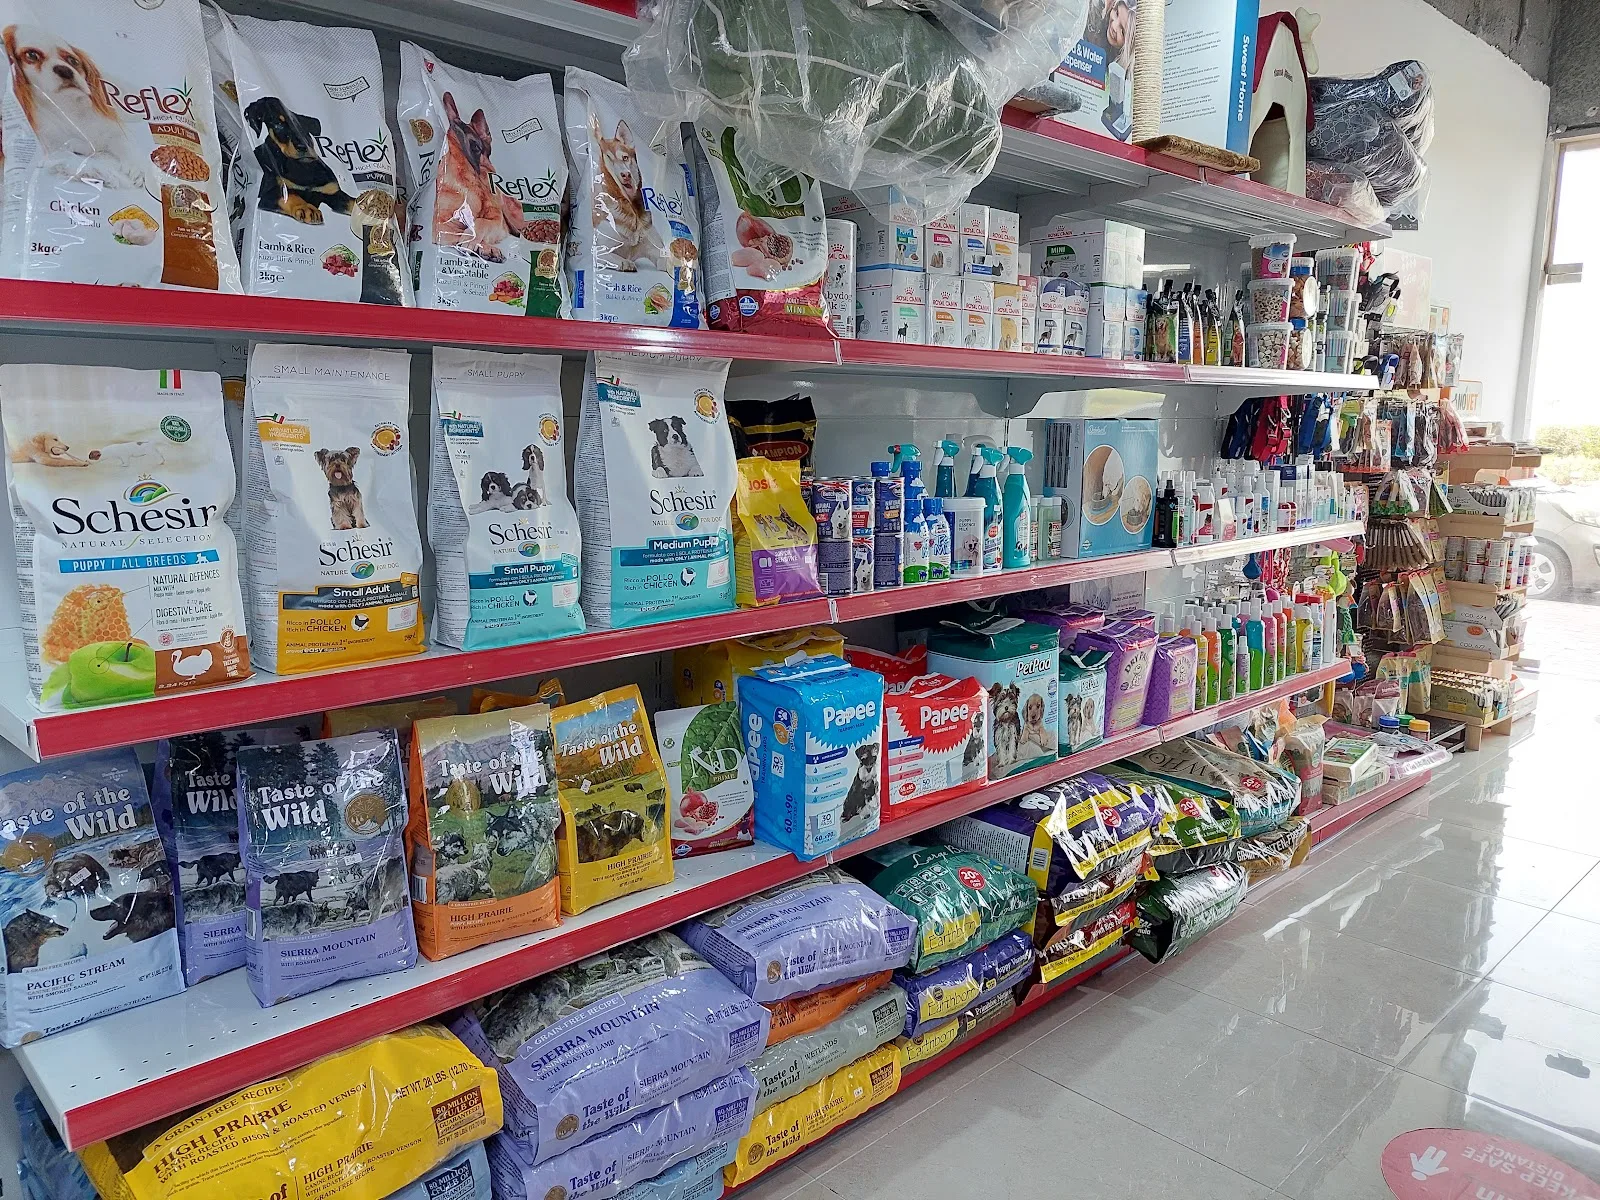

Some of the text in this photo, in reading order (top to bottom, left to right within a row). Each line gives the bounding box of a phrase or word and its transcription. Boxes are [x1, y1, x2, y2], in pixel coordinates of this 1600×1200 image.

[1082, 45, 1103, 65] Water
[1236, 34, 1250, 122] Sweet Home
[99, 79, 195, 121] Reflex
[157, 125, 186, 136] ADULT
[314, 136, 391, 171] Reflex
[488, 171, 559, 200] Reflex
[259, 241, 315, 255] Lamb Rice
[273, 365, 390, 381] SMALL MAINTENANCE
[467, 369, 526, 379] SMALL PUPPY
[649, 489, 717, 515] Schesir
[51, 497, 218, 535] Schesir
[61, 534, 213, 549] NATURAL SELECTION
[488, 522, 553, 546] Schesir
[653, 540, 692, 550] Medium
[73, 554, 187, 572] PUPPY ALL BREEDS
[318, 538, 393, 566] Schesir
[152, 573, 188, 585] NATURAL
[504, 563, 556, 575] Small Puppy
[646, 573, 674, 582] POLLO
[333, 583, 391, 597] Small Adult
[643, 580, 678, 590] CHICKEN
[155, 605, 193, 618] DIGESTIVE
[487, 600, 520, 609] CHICKEN
[306, 624, 347, 632] CHICKEN
[309, 618, 341, 626] POLLO
[1015, 656, 1052, 677] PetPad
[1124, 652, 1139, 674] DRY
[823, 700, 876, 730] Papee
[920, 703, 969, 730] Papee
[560, 723, 638, 757] Taste the
[600, 736, 644, 766] Wild
[437, 752, 510, 777] Taste of
[773, 755, 780, 771] 30
[185, 770, 231, 788] Taste
[488, 764, 549, 795] Wild
[712, 773, 735, 783] PRIME
[922, 778, 931, 786] 50
[63, 786, 131, 814] of the
[257, 784, 315, 805] Taste
[65, 803, 137, 840] Wild
[261, 799, 329, 831] Wild
[784, 819, 793, 834] 60
[822, 813, 831, 822] 30
[607, 851, 654, 871] HIGH PRAIRIE
[913, 851, 949, 868] Large
[450, 905, 514, 922] HIGH PRAIRIE
[736, 894, 833, 935] SIERRA MOUNTAIN
[737, 902, 773, 921] GRAIN-FREE
[203, 925, 242, 939] SIERRA
[762, 921, 787, 937] ROASTED
[280, 932, 377, 958] SIERRA MOUNTAIN
[807, 950, 818, 962] of
[27, 973, 76, 991] PACIFIC
[79, 957, 126, 979] STREAM
[295, 957, 321, 967] ROASTED
[797, 962, 817, 977] Wild
[45, 987, 72, 998] SMOKED
[73, 980, 98, 991] SALMON
[927, 986, 977, 1017] Earthborn
[73, 1016, 85, 1024] of
[534, 1012, 587, 1045] GRAIN-FREE
[587, 998, 618, 1016] RECIPE
[530, 1002, 661, 1072] SIERRA MOUNTAIN
[906, 1027, 955, 1061] Earthborn
[536, 1042, 591, 1077] CANINE RECIPE
[539, 1039, 616, 1081] WITH ROASTED LAMB
[804, 1038, 838, 1061] WETLANDS
[396, 1062, 469, 1100] NET WT. 28 LBS. (12.70
[639, 1070, 669, 1089] SIERRA
[671, 1050, 711, 1075] MOUNTAIN
[761, 1070, 787, 1088] Taste
[789, 1059, 799, 1072] of
[763, 1070, 801, 1098] the Wild
[435, 1090, 478, 1116] 80 MILLION
[468, 1097, 479, 1109] OF
[582, 1086, 630, 1118] Taste of
[604, 1099, 632, 1120] Wild
[805, 1096, 845, 1122] HIGH PRAIRIE
[153, 1099, 239, 1153] A GRAIN-FREE
[439, 1105, 481, 1129] GUARANTEED
[153, 1099, 292, 1175] HIGH PRAIRIE
[160, 1082, 368, 1185] WITH ROASTED BISON ROASTED VENISON
[655, 1125, 697, 1148] MOUNTAIN
[765, 1120, 799, 1146] Taste of
[766, 1131, 801, 1157] the Wild
[157, 1134, 236, 1179] CANINE RECIPE
[303, 1141, 375, 1184] HIGH PRAIRIE
[305, 1137, 422, 1197] WITH ROASTED VENISON
[1460, 1146, 1516, 1175] SAFE
[1482, 1143, 1565, 1182] DISTANCE
[314, 1164, 376, 1200] GRAIN-FREE RECIPE
[438, 1165, 469, 1183] MILLION
[569, 1160, 617, 1190] Taste of
[591, 1173, 617, 1191] Wild
[1519, 1171, 1577, 1198] KEEP
[270, 1184, 289, 1200] of
